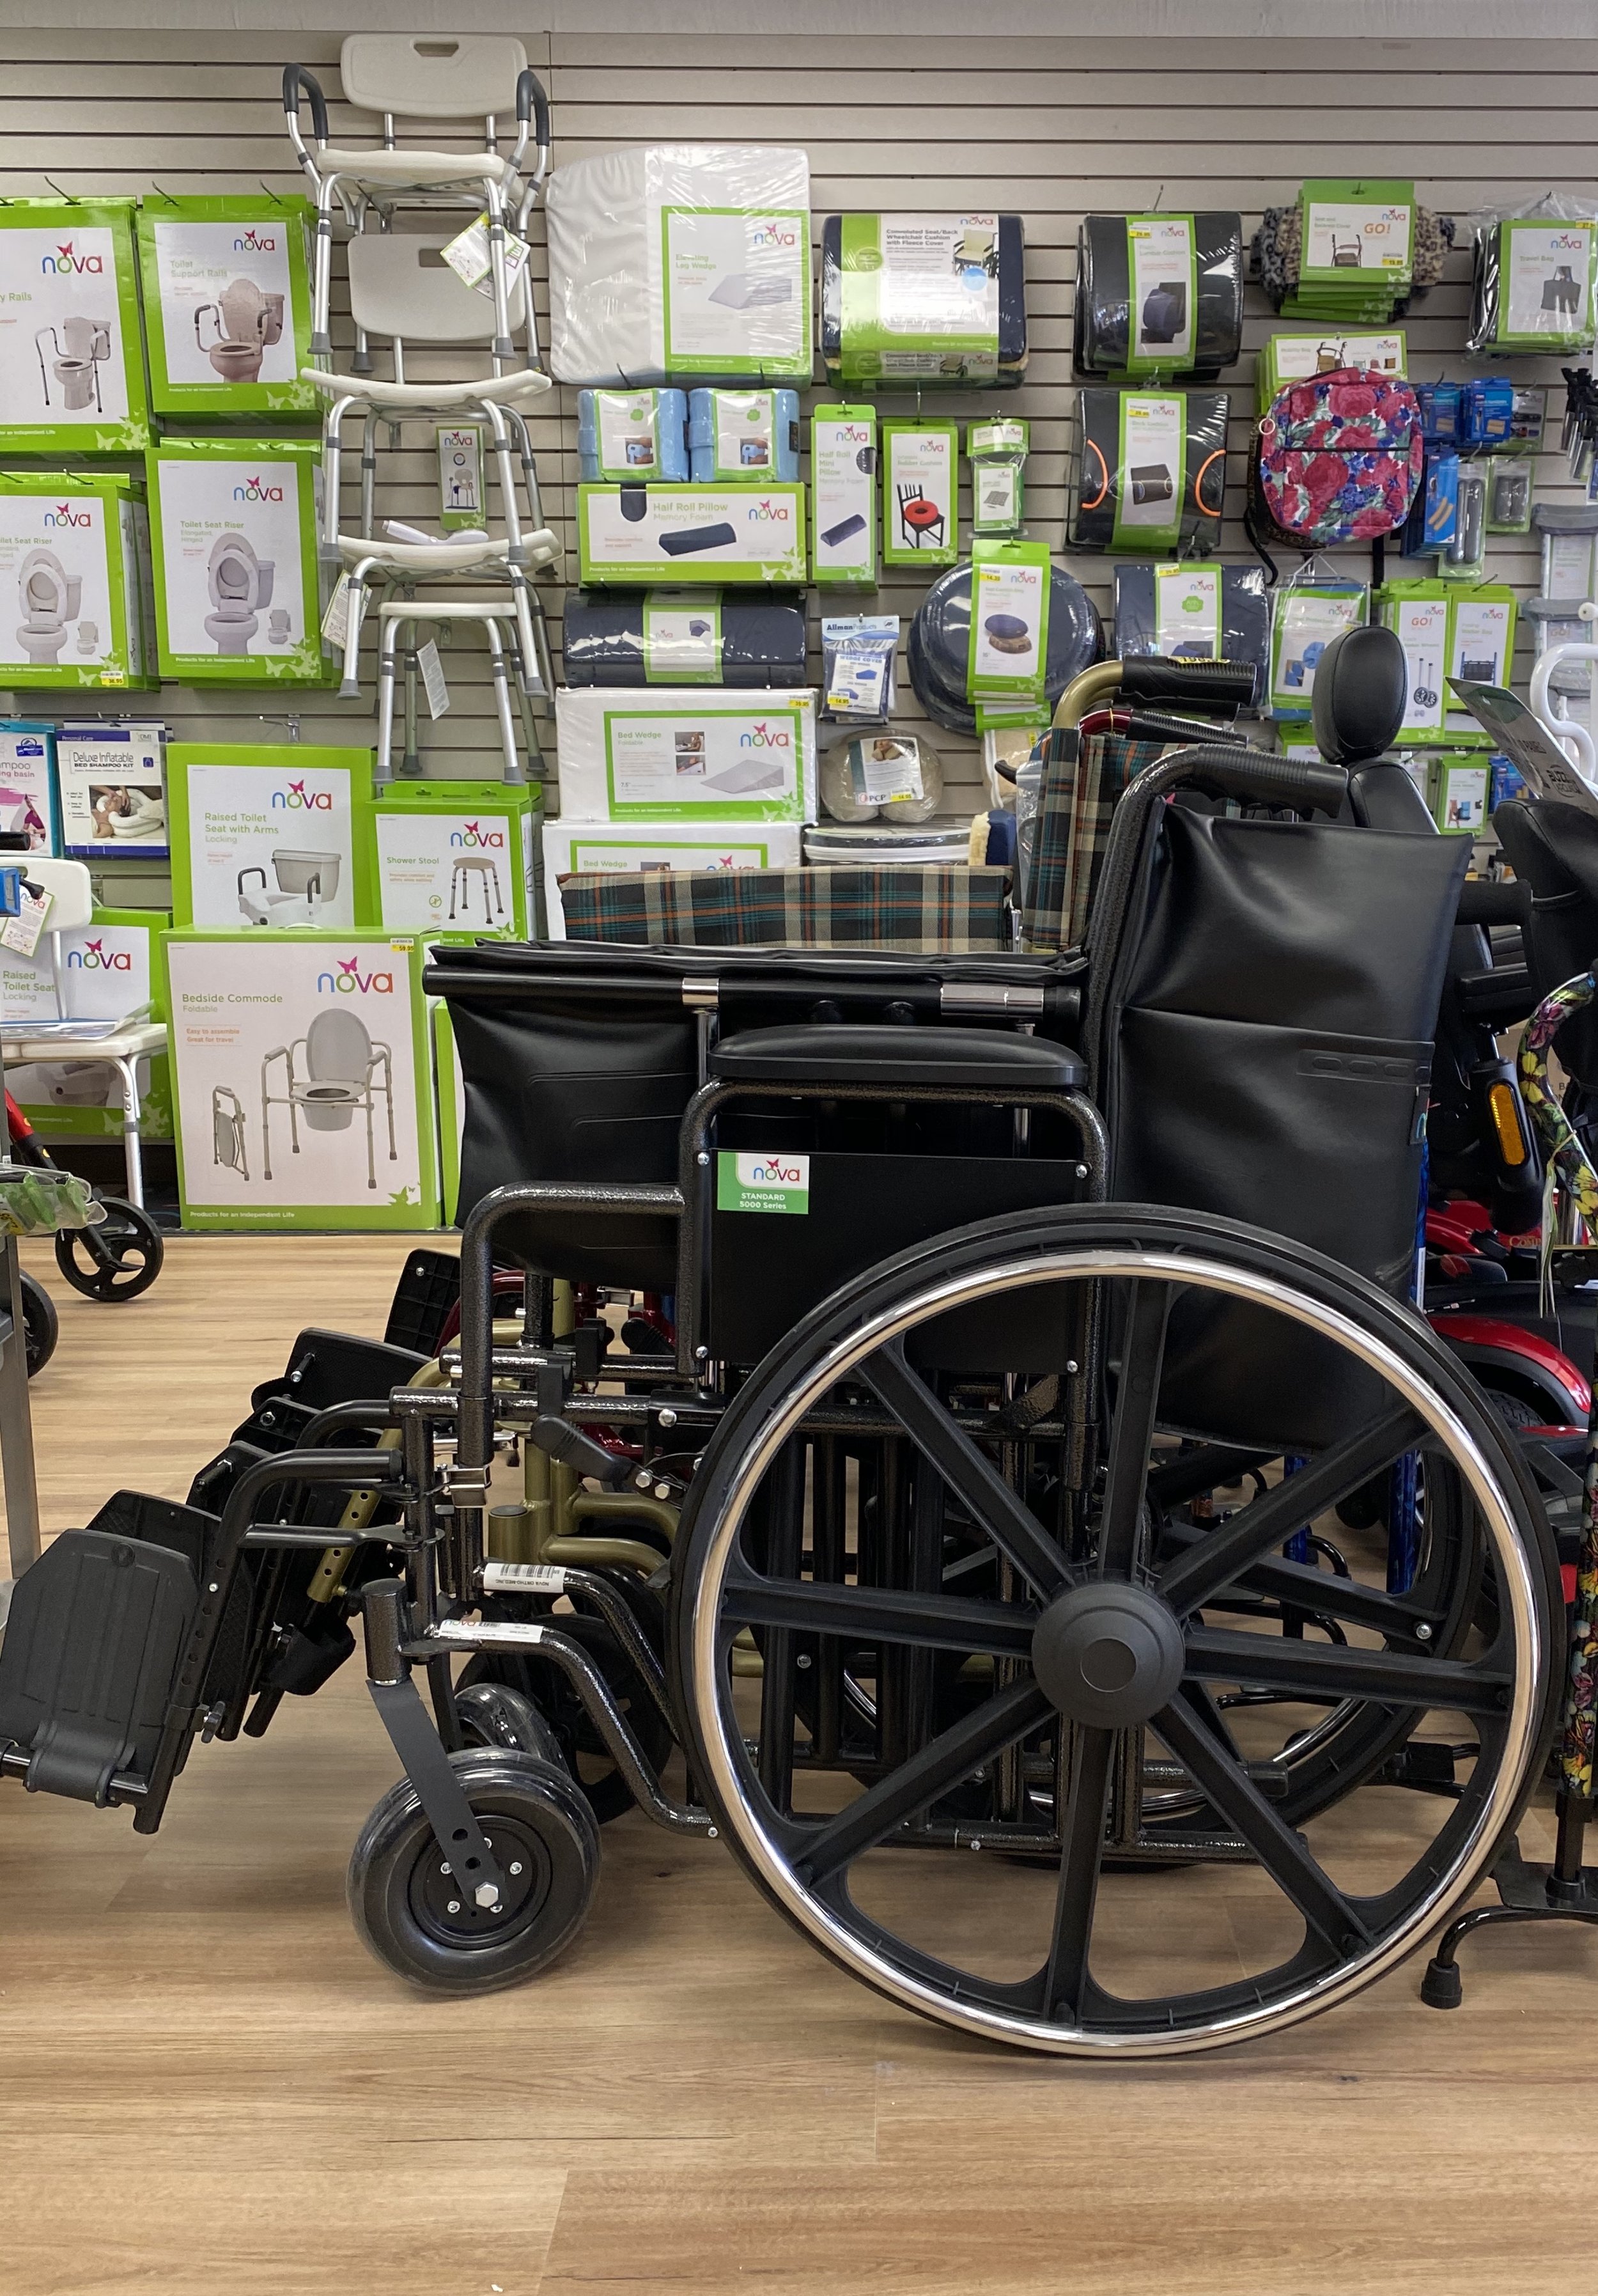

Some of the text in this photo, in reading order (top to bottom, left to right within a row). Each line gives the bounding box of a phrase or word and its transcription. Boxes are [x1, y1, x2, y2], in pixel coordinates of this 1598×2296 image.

[1365, 223, 1391, 234] GO!
[754, 231, 795, 246] nova
[233, 238, 275, 251] nova
[1551, 239, 1582, 249] nova
[42, 256, 104, 274] nova
[171, 269, 205, 279] Support
[9, 292, 32, 301] Rails
[445, 437, 472, 446] nova
[836, 432, 868, 442] nova
[920, 444, 943, 453] nova
[233, 487, 283, 502] nova
[653, 503, 729, 512] Half Roll Pillow
[653, 513, 688, 522] Memory
[749, 508, 788, 520] nova
[44, 513, 91, 527] nova
[1011, 575, 1037, 584] nova
[1411, 617, 1432, 626] GO!
[740, 732, 789, 747] nova
[73, 752, 134, 763] Deluxe Inflatable
[272, 792, 332, 811] nova
[205, 812, 267, 823] Raised Toilet
[205, 824, 279, 834] Seat with Arms
[205, 835, 238, 845] Locking
[450, 832, 504, 848] nova
[67, 951, 132, 971] nova
[3, 971, 36, 980] Raised
[3, 981, 56, 992] Toilet Seat
[317, 972, 394, 994] nova
[3, 993, 37, 1002] Locking
[182, 994, 283, 1004] Bedside Commode
[182, 1004, 218, 1013] Foldable
[186, 1028, 201, 1036] Easy
[754, 1167, 800, 1182] nova
[741, 1192, 786, 1201] STANDARD
[763, 1201, 787, 1210] Series
